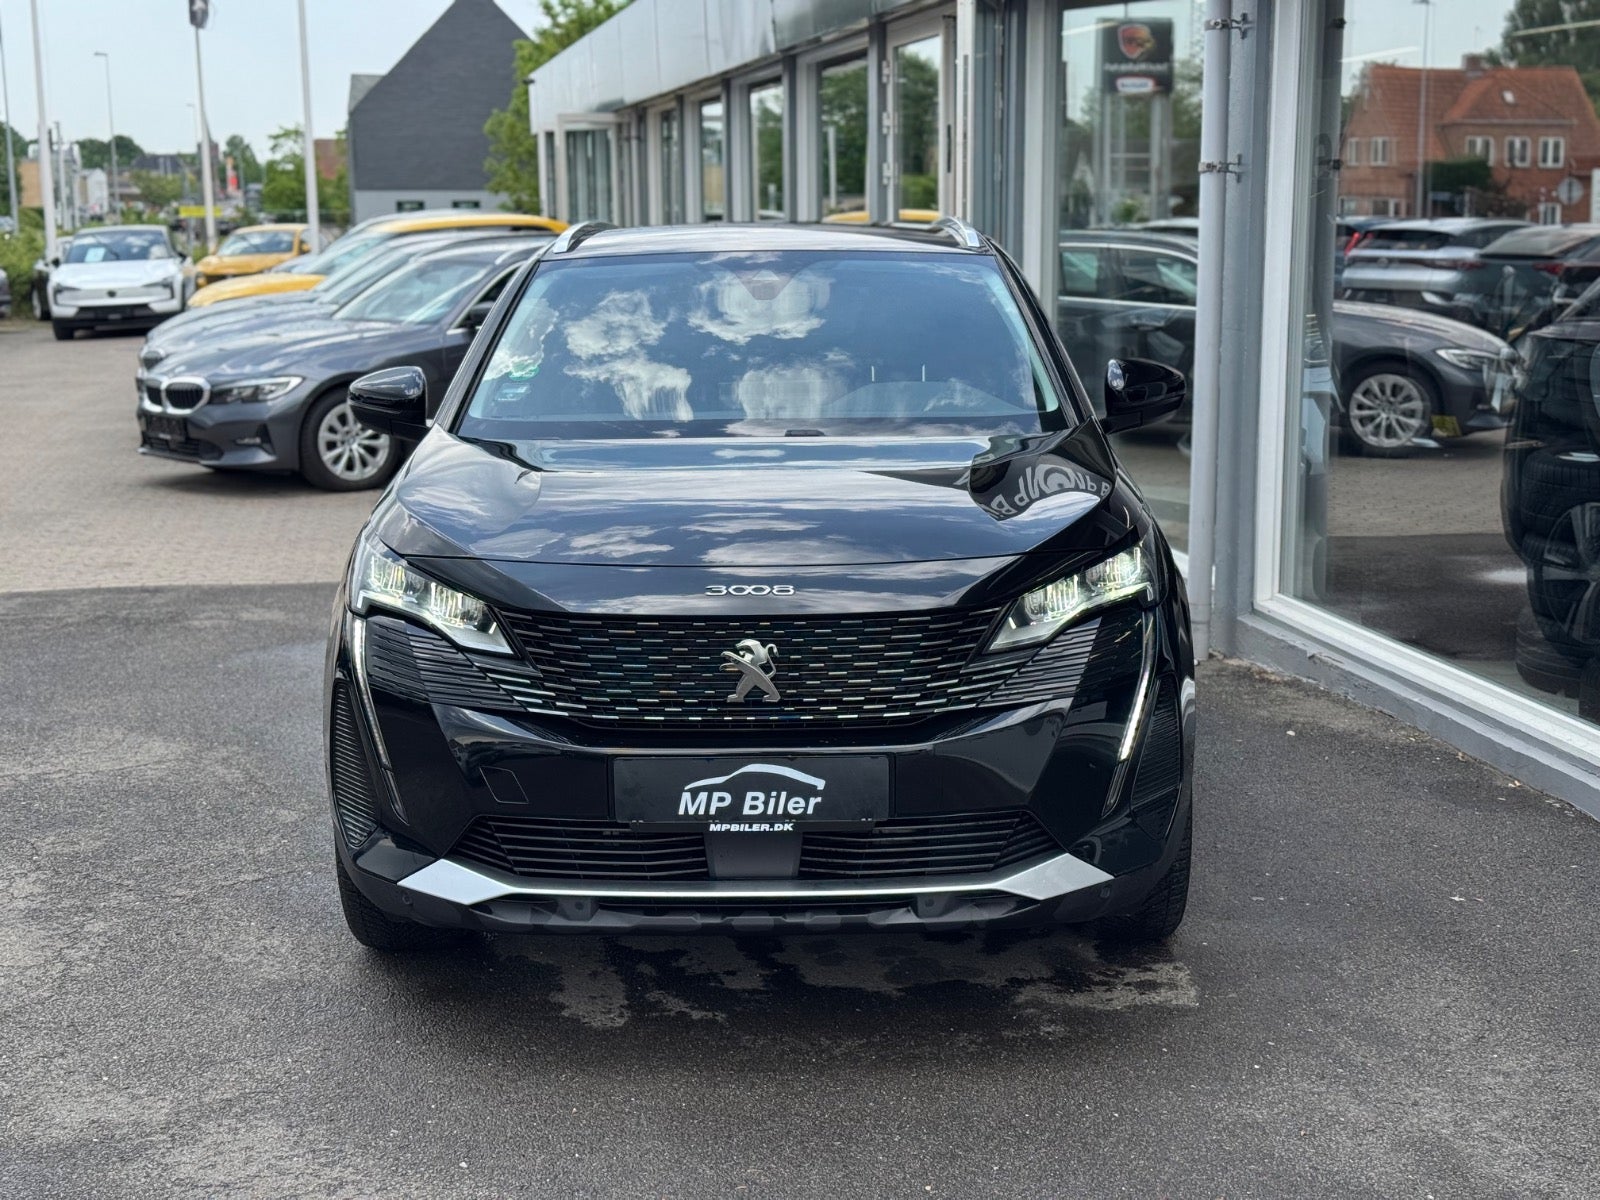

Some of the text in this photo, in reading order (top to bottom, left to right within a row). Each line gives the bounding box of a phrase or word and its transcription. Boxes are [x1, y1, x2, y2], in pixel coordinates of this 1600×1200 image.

[705, 585, 795, 596] 3008
[678, 791, 822, 815] MP Biler
[709, 823, 794, 832] MPBILER.DK
